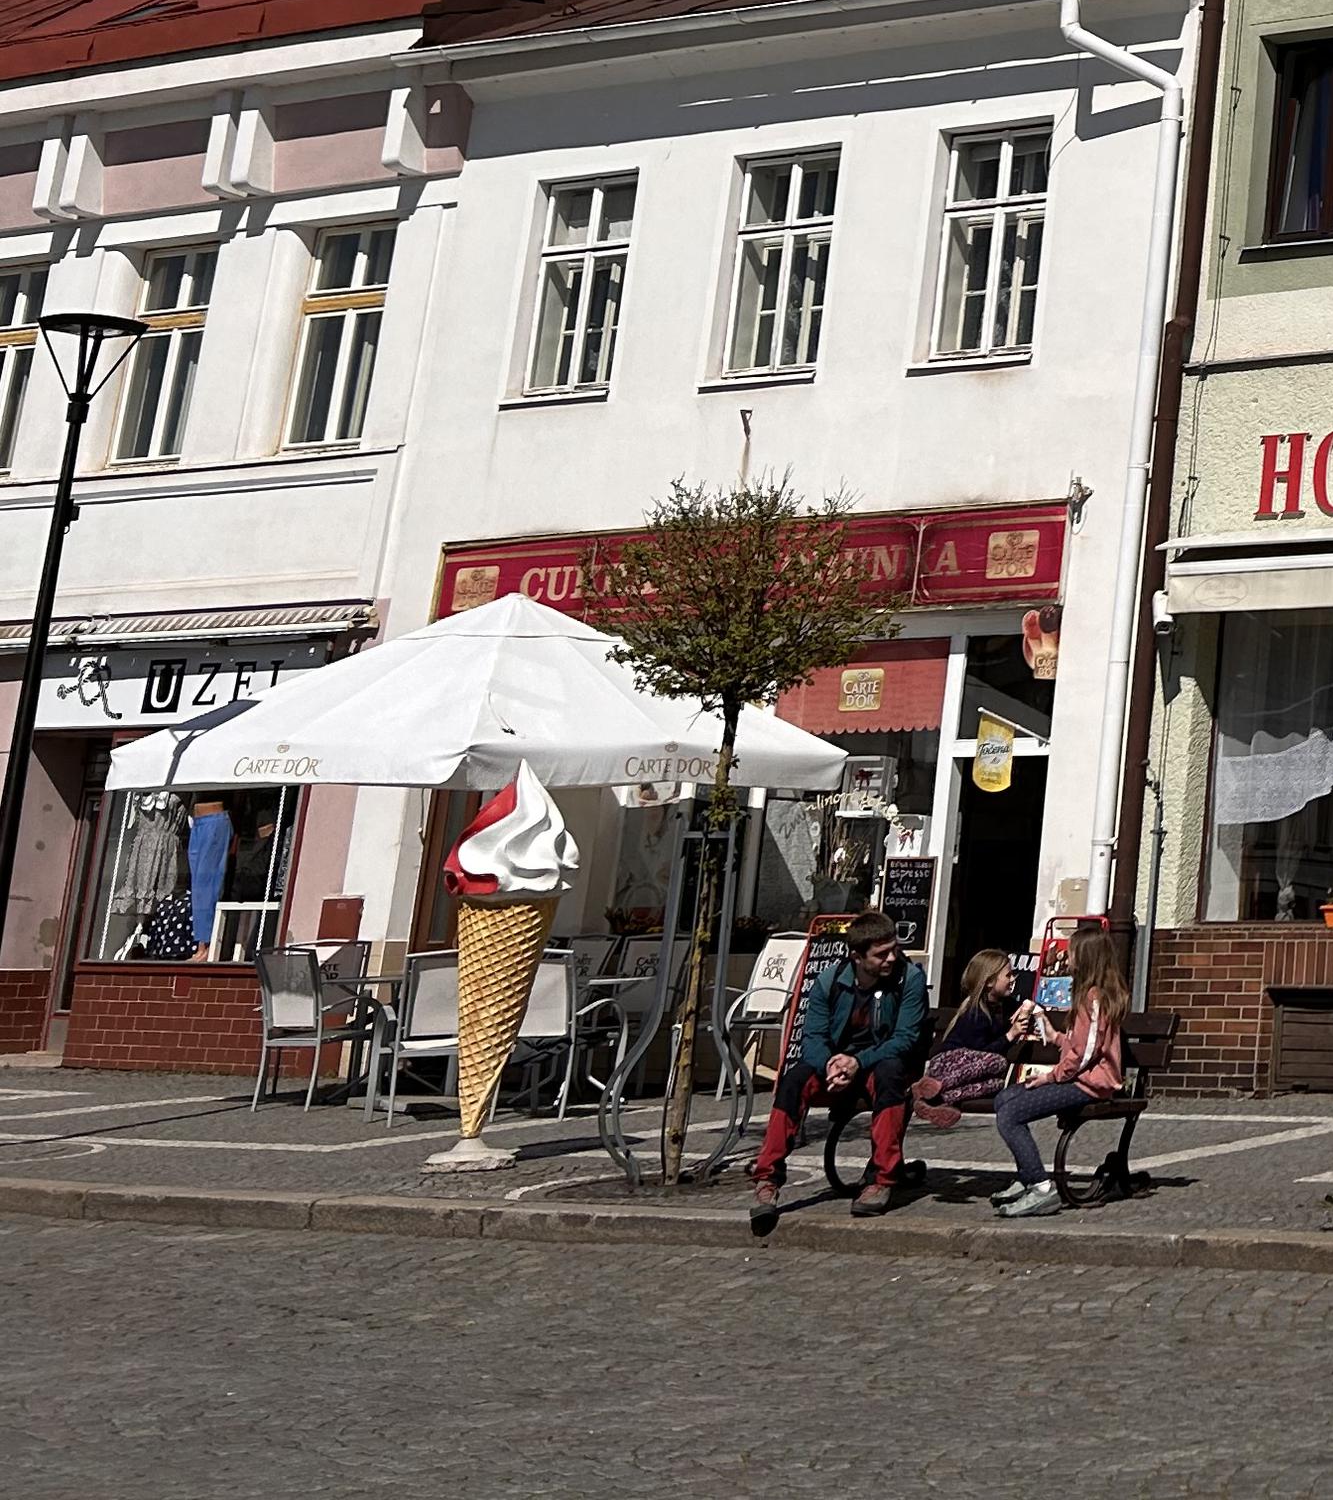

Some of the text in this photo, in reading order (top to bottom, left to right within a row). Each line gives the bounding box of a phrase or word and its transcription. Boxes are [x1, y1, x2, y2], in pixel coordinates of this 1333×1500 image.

[843, 680, 880, 695] CARTE
[846, 694, 876, 708] D'OR
[233, 756, 321, 777] CARTE D'OR
[625, 756, 715, 779] CARTE D'OR
